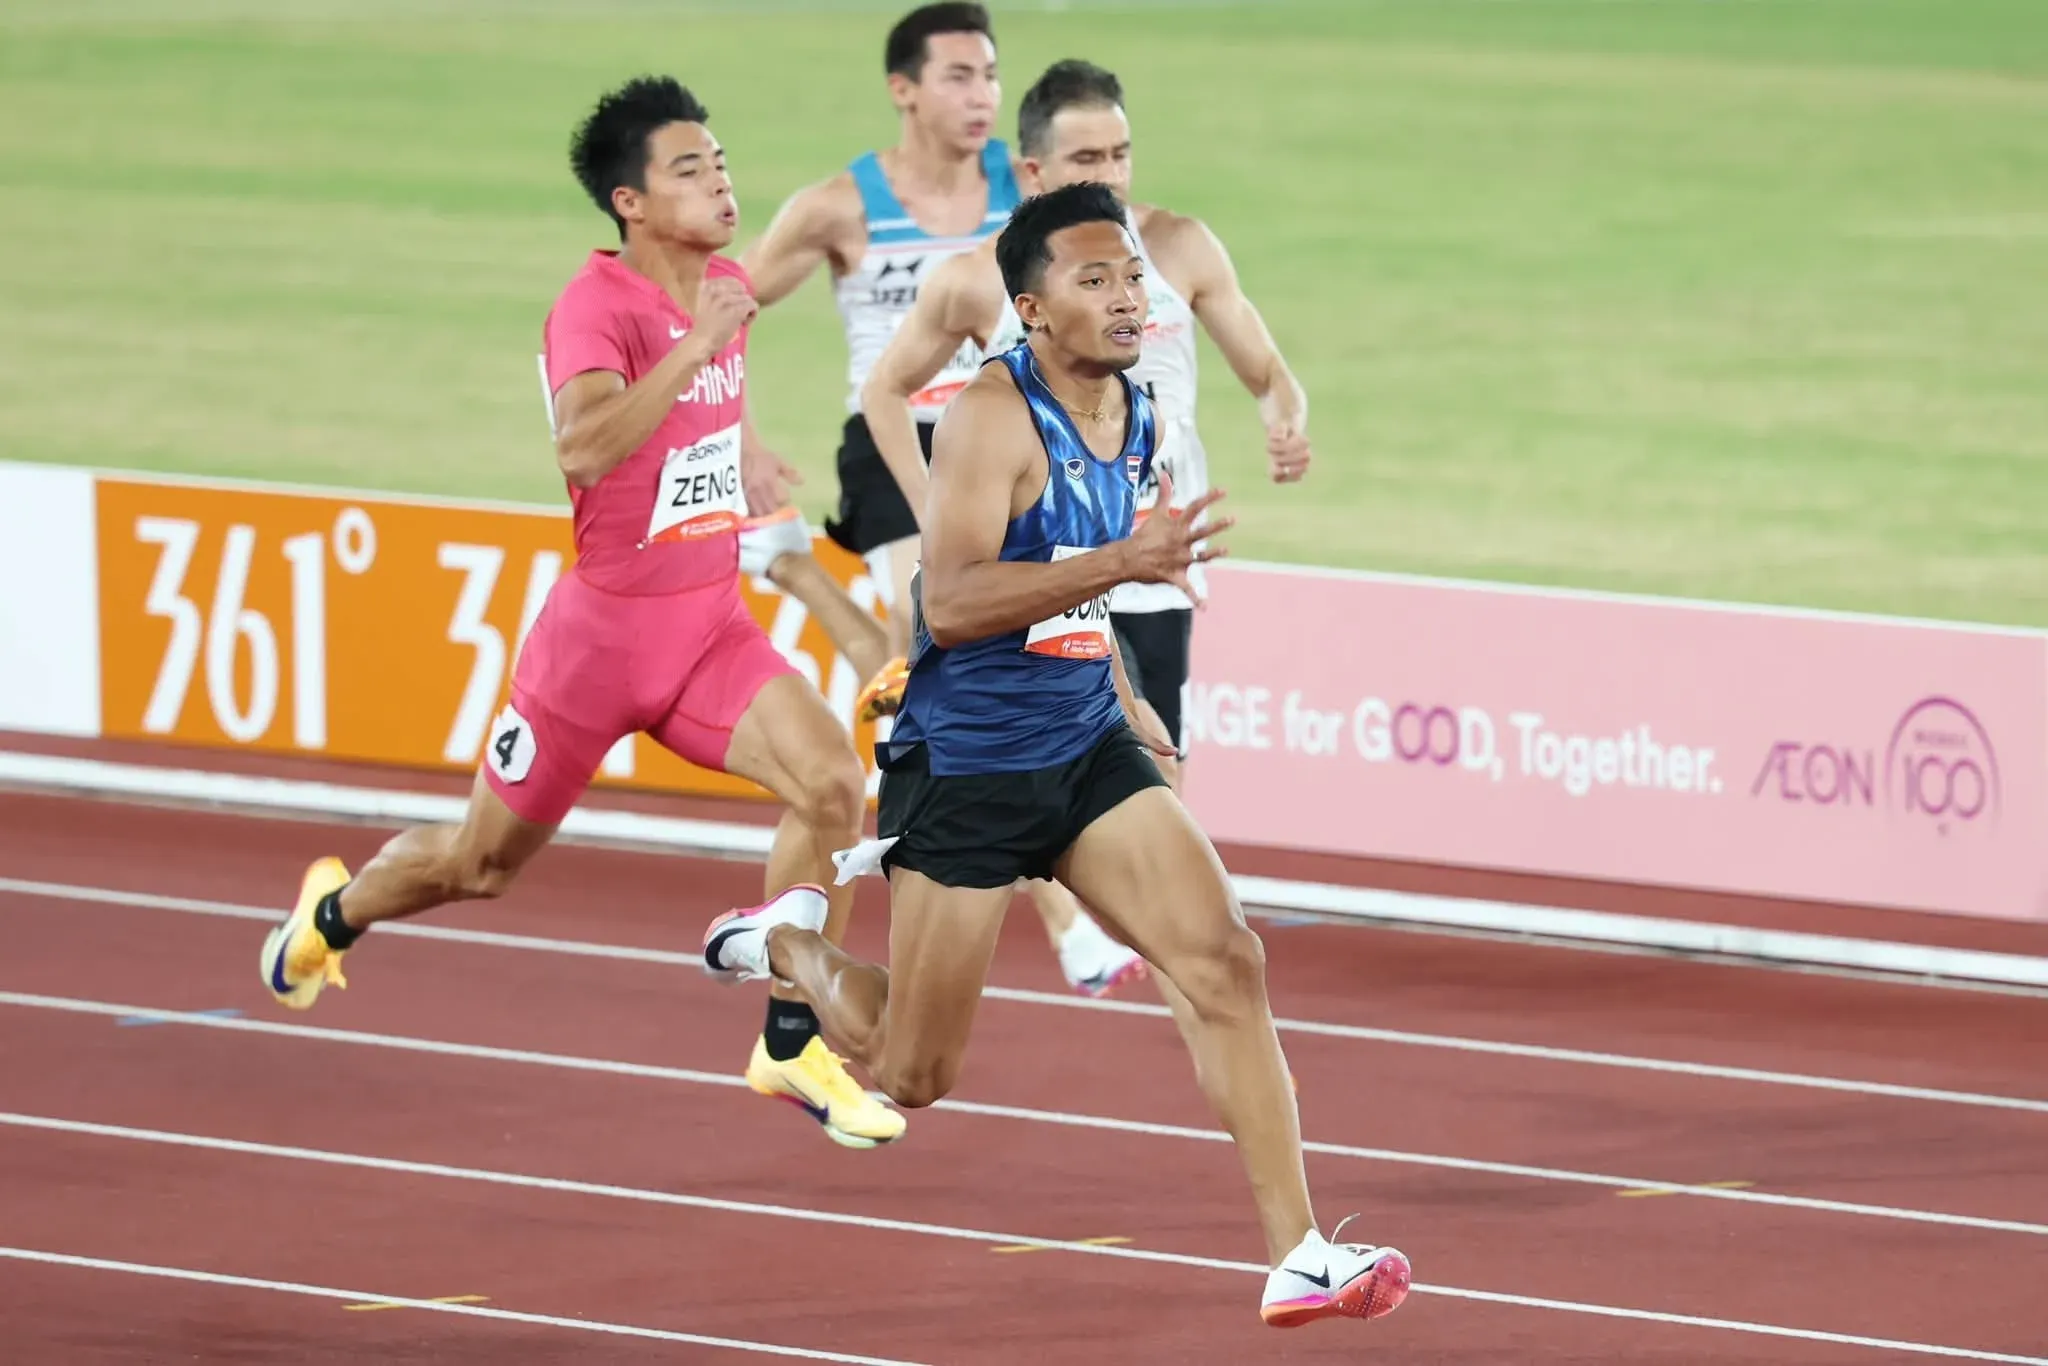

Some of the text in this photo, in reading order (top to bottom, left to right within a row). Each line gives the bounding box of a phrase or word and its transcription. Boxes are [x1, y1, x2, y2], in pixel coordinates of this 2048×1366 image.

[672, 464, 737, 507] ZENG
[495, 726, 521, 770] 4
[1284, 689, 1344, 756] for
[1353, 697, 1504, 782] GOOD,
[1507, 711, 1724, 797] Together.
